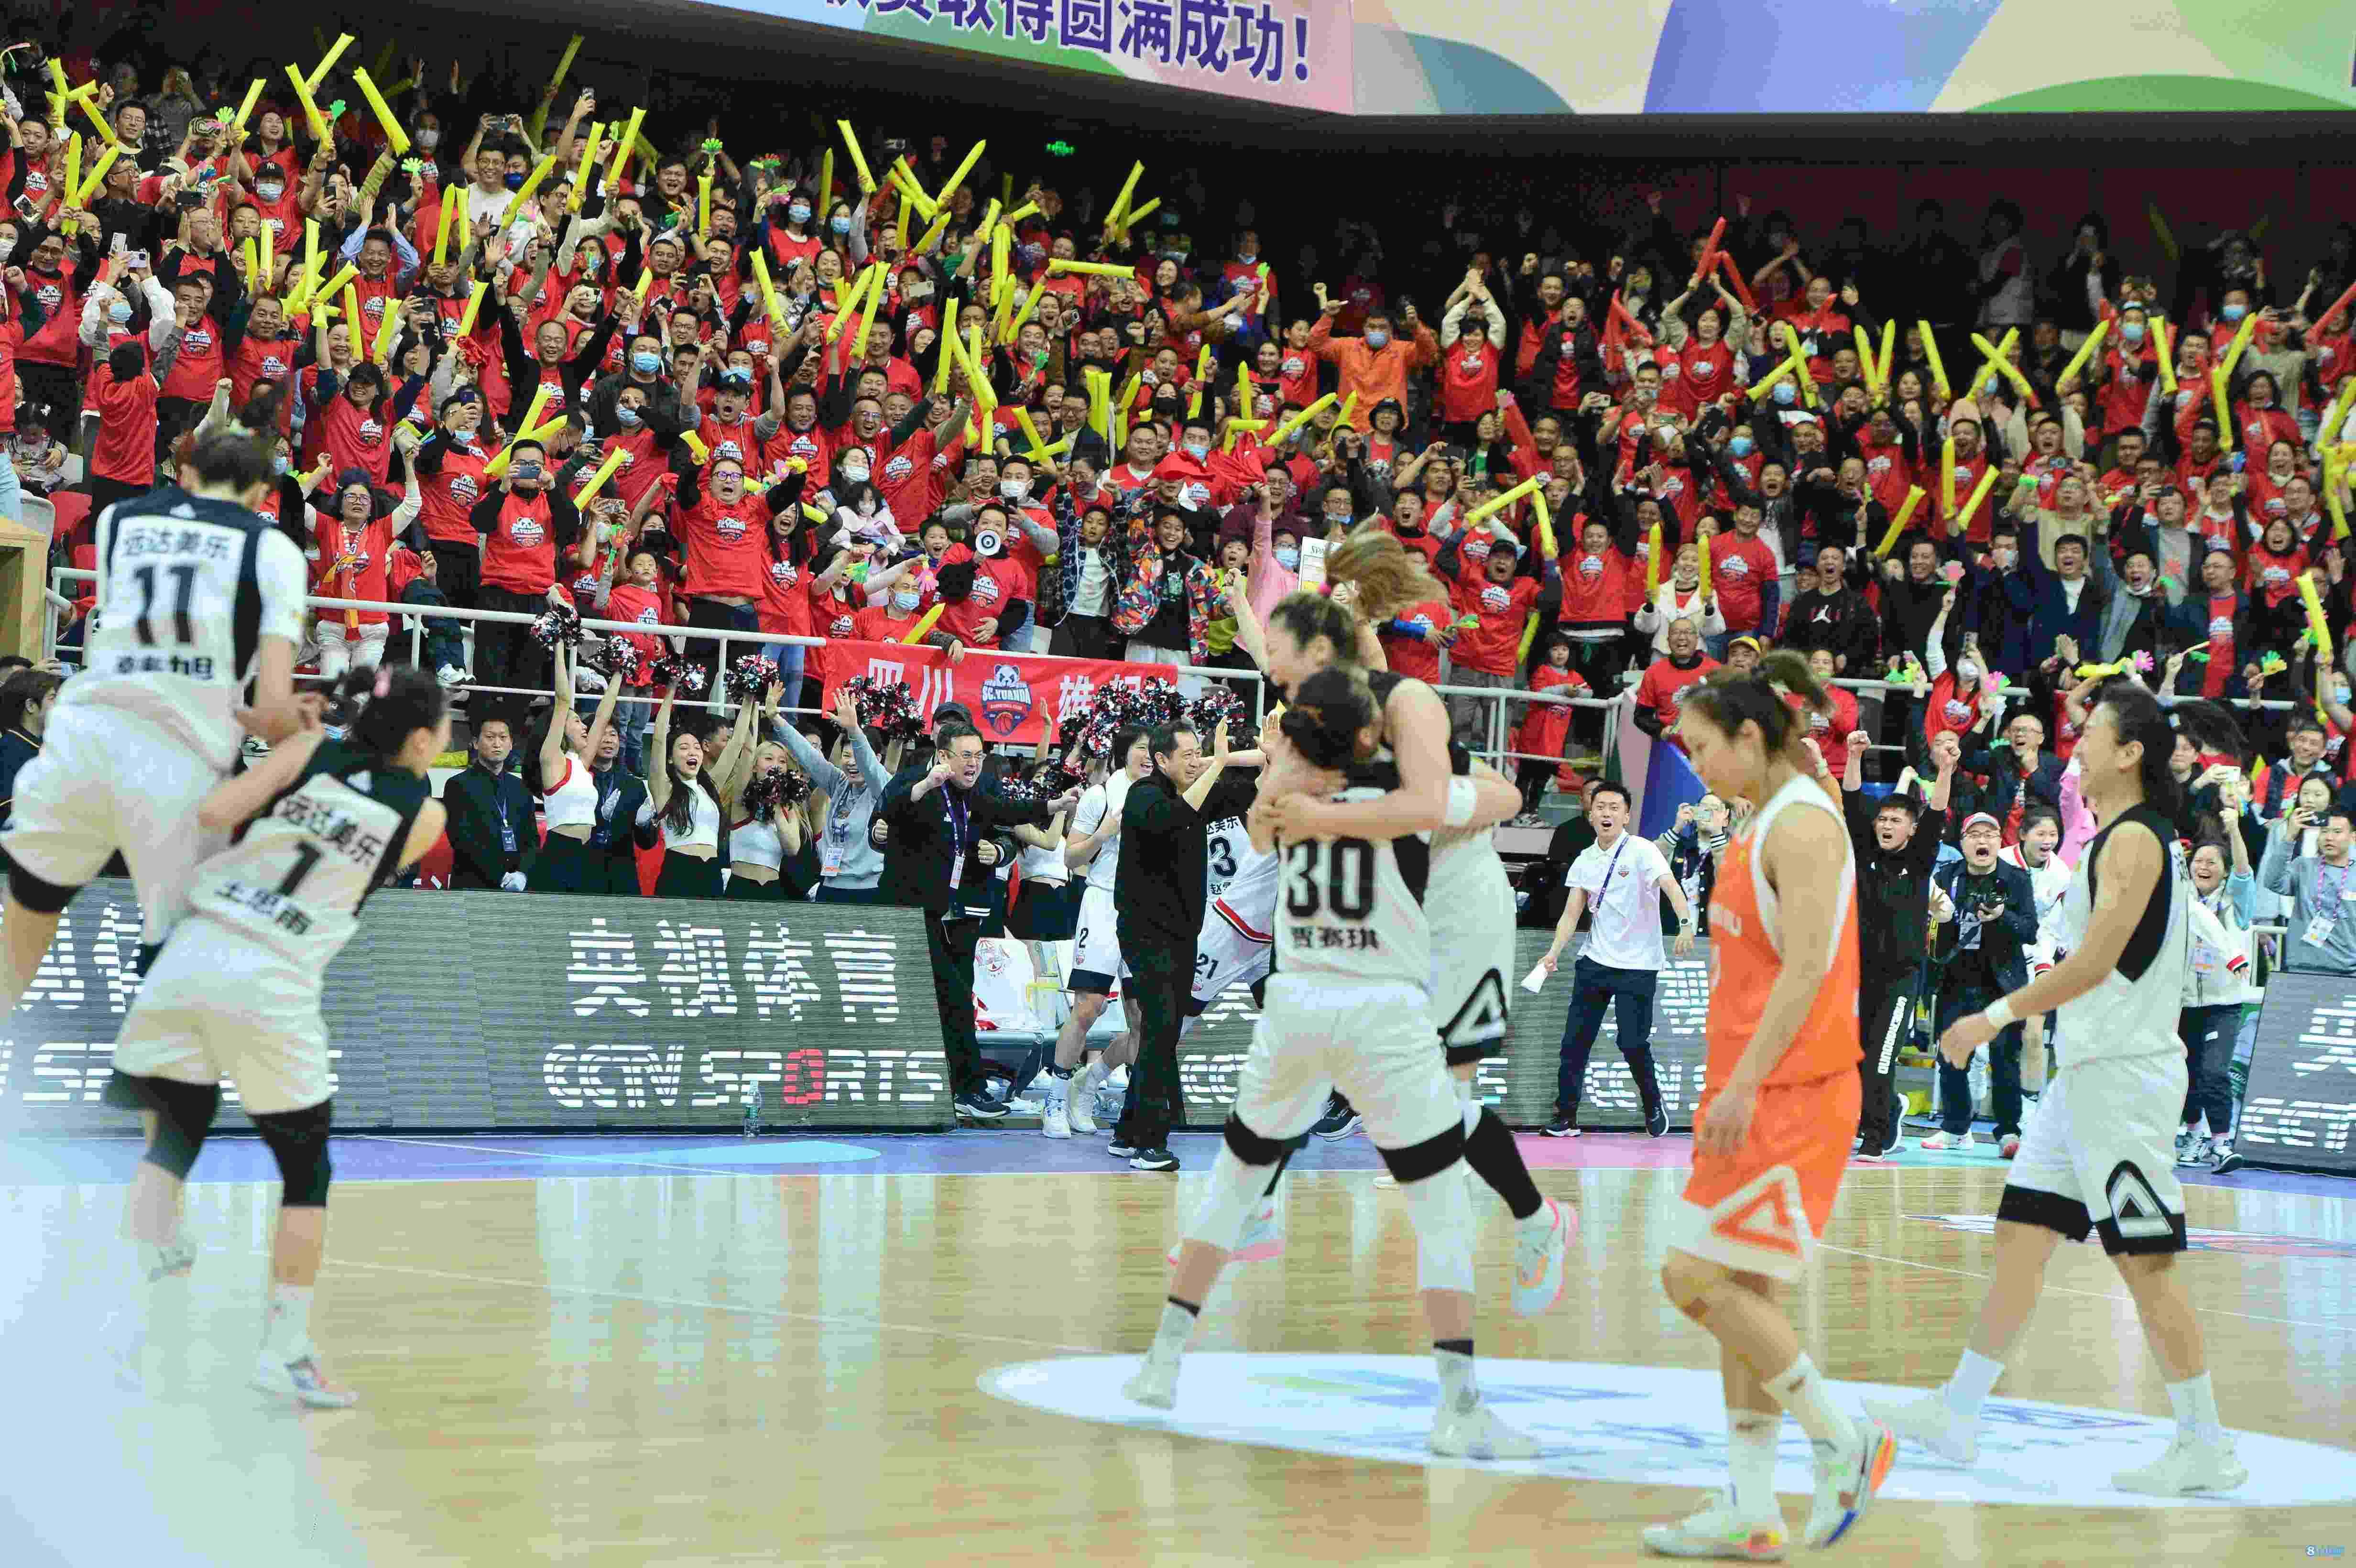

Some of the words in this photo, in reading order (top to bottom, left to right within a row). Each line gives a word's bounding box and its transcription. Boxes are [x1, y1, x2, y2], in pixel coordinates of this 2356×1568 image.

[826, 0, 1308, 81] 取得圆满成功!
[134, 562, 199, 645] 11
[282, 839, 325, 897] 1
[1209, 835, 1239, 878] 3
[1286, 838, 1376, 921] 30
[1079, 927, 1089, 948] 2
[1193, 953, 1219, 980] 21
[692, 1048, 947, 1107] SPORTS
